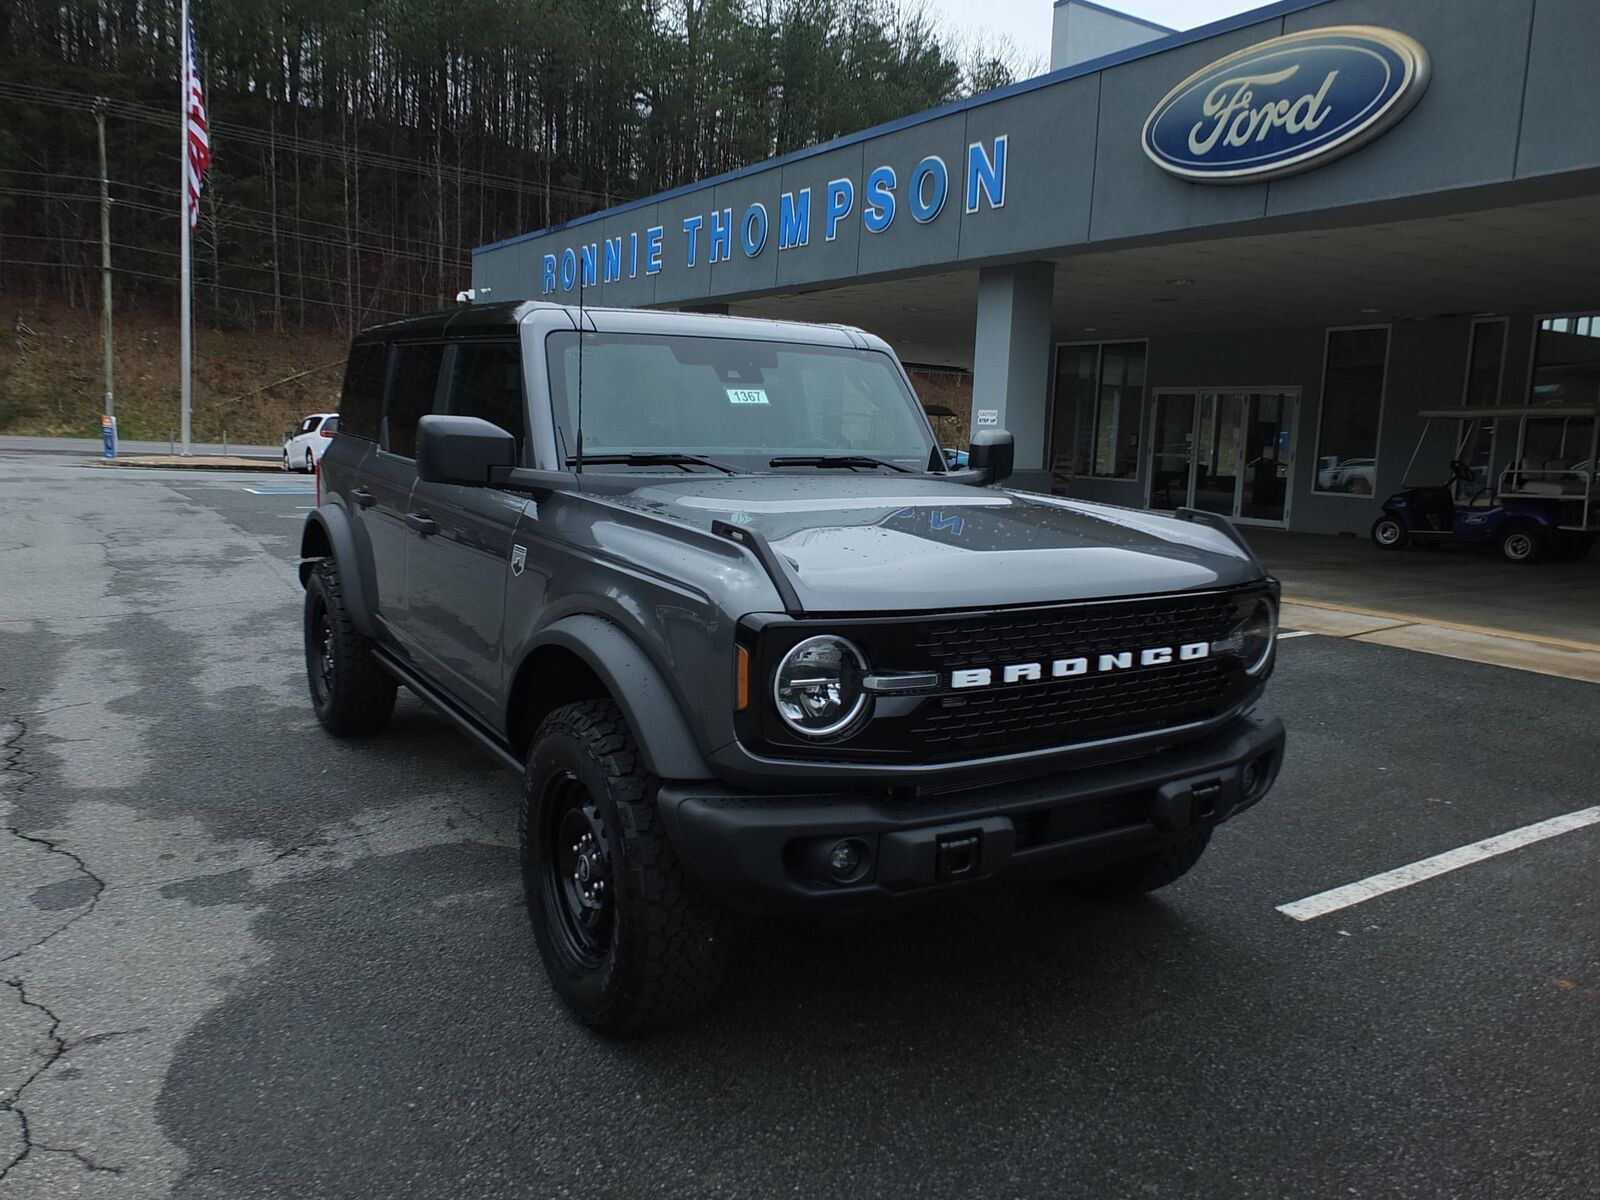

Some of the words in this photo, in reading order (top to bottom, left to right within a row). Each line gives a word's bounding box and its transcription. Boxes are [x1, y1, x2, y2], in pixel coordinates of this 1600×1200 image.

[1188, 64, 1339, 155] Ford
[543, 225, 664, 294] RONNIE
[683, 135, 1008, 267] THOMPSON
[733, 391, 761, 402] 1367
[952, 642, 1209, 688] BRONCO
